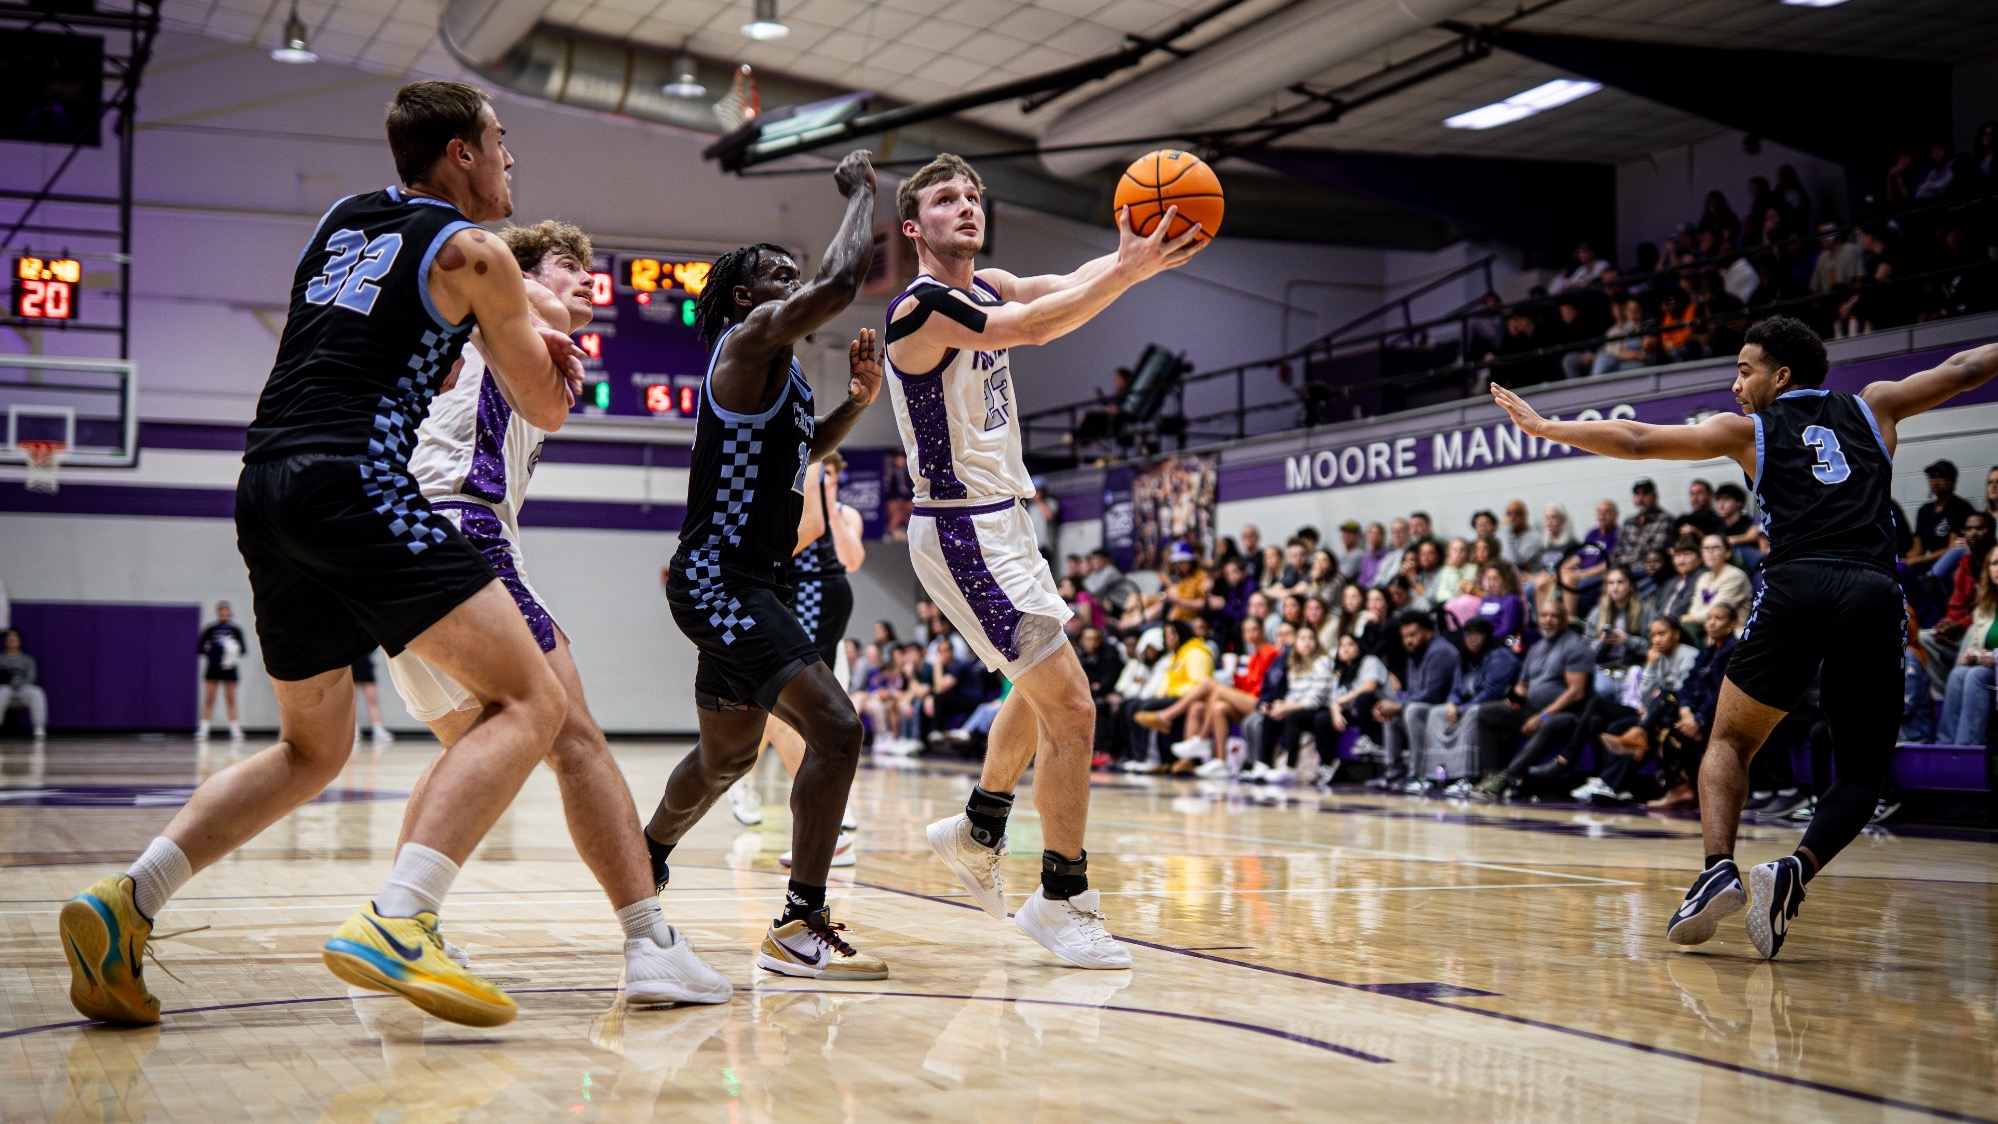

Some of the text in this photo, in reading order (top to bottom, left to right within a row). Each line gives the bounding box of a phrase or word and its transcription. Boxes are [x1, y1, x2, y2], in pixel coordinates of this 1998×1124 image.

[21, 281, 70, 318] 20
[305, 228, 403, 316] 32
[1284, 437, 1418, 491] MOORE
[1801, 425, 1852, 485] 3
